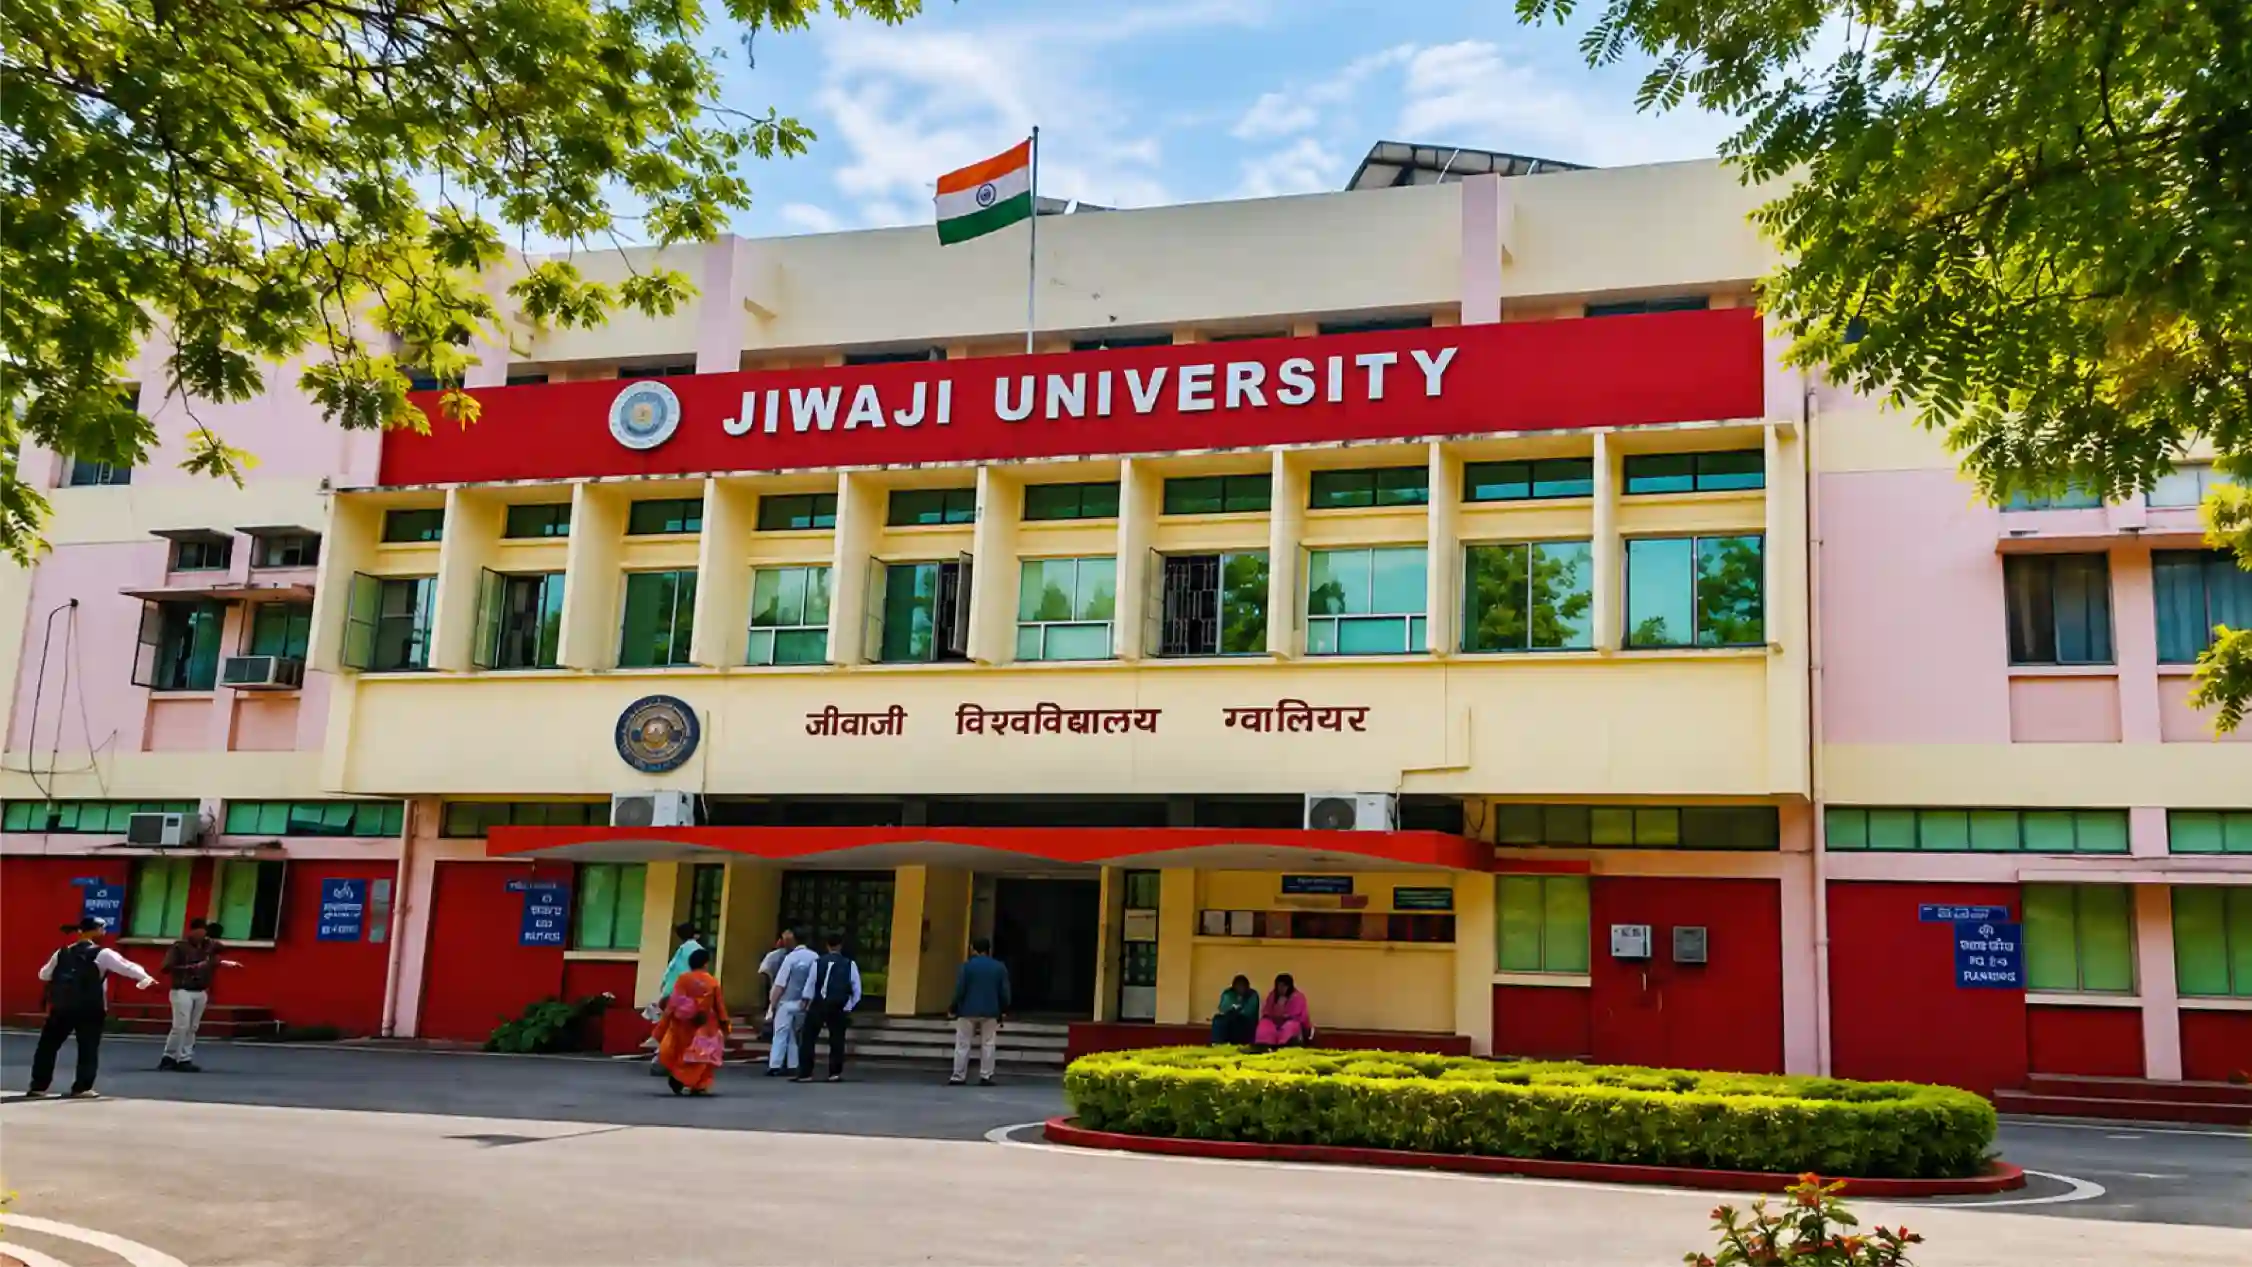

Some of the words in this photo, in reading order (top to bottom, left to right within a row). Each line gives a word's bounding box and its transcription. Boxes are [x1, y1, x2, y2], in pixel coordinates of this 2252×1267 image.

[722, 379, 953, 435] JIWAJI
[995, 346, 1459, 422] UNIVERSITY
[805, 704, 909, 736] जीवाजी
[954, 702, 1164, 736] विश्वविद्यालय
[1222, 698, 1371, 733] ग्वालियर
